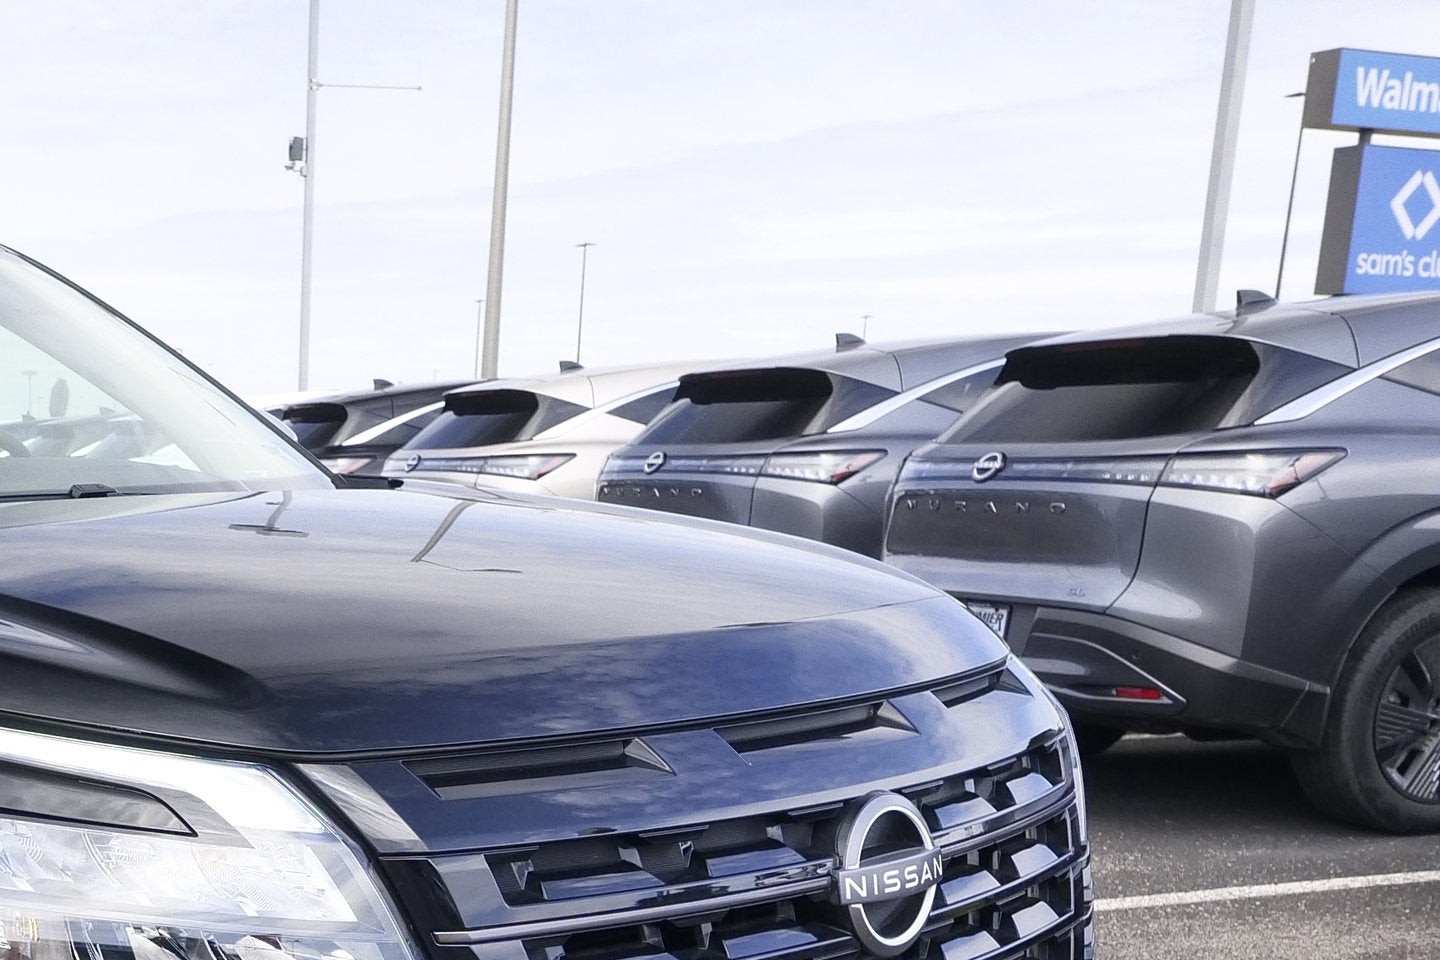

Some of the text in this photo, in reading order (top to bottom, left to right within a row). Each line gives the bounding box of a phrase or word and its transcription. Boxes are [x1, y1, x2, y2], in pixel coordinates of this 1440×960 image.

[1356, 66, 1440, 113] Walm
[1356, 249, 1415, 277] sam's
[906, 499, 1066, 514] MURANO
[844, 854, 943, 900] NISSAN
